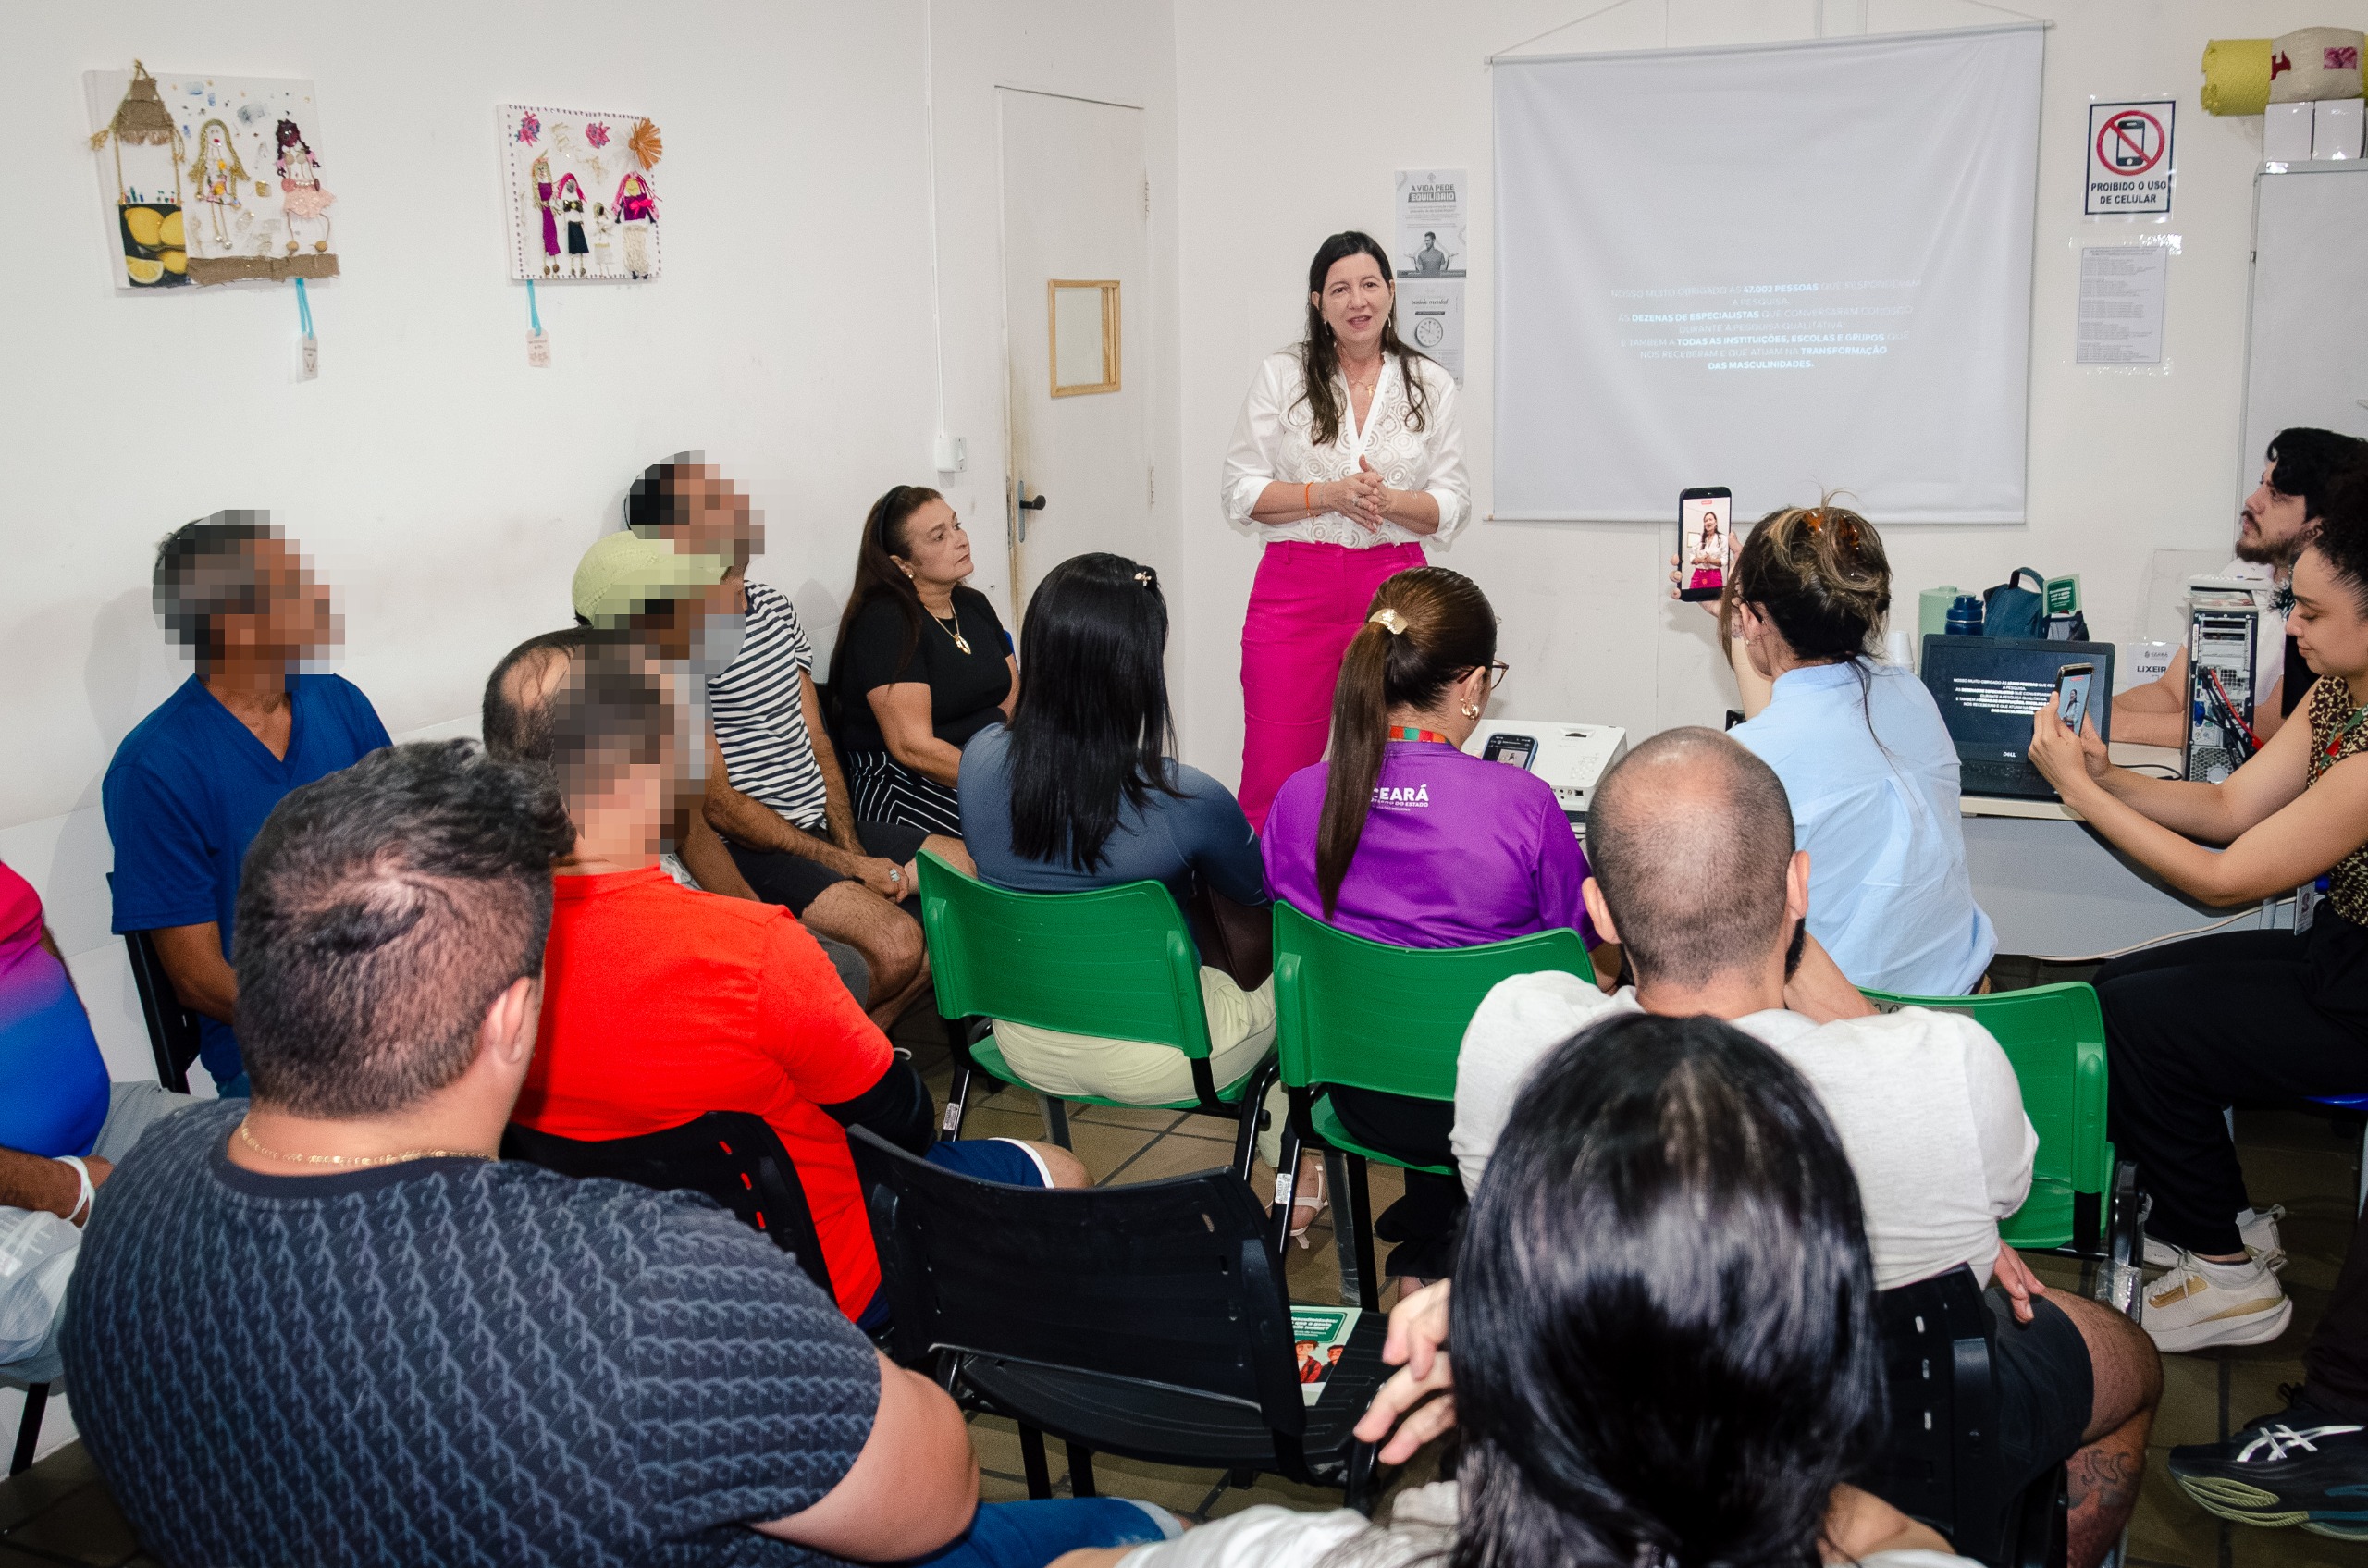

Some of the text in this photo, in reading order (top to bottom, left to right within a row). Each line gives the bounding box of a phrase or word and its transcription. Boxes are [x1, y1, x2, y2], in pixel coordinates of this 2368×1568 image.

[2090, 180, 2166, 191] PROIBIDO O USO
[2100, 194, 2156, 204] DE CELULAR
[1743, 284, 1772, 293] 47.002
[1774, 283, 1819, 292] PESSOAS
[1632, 314, 1674, 323] DEZENAS
[1675, 313, 1688, 322] DE
[1689, 310, 1759, 321] ESPECIALISTAS
[1676, 337, 1708, 346] TODAS
[1708, 336, 1721, 345] AS
[1723, 333, 1790, 345] INSTITUIÇÕES,
[1791, 333, 1835, 343] ESCOLAS
[1837, 333, 1844, 341] E
[1844, 332, 1885, 342] GRUPOS
[1801, 344, 1888, 356] TRANSFORMAÇÃO
[1708, 359, 1815, 370] DAS MASCULINIDADES.
